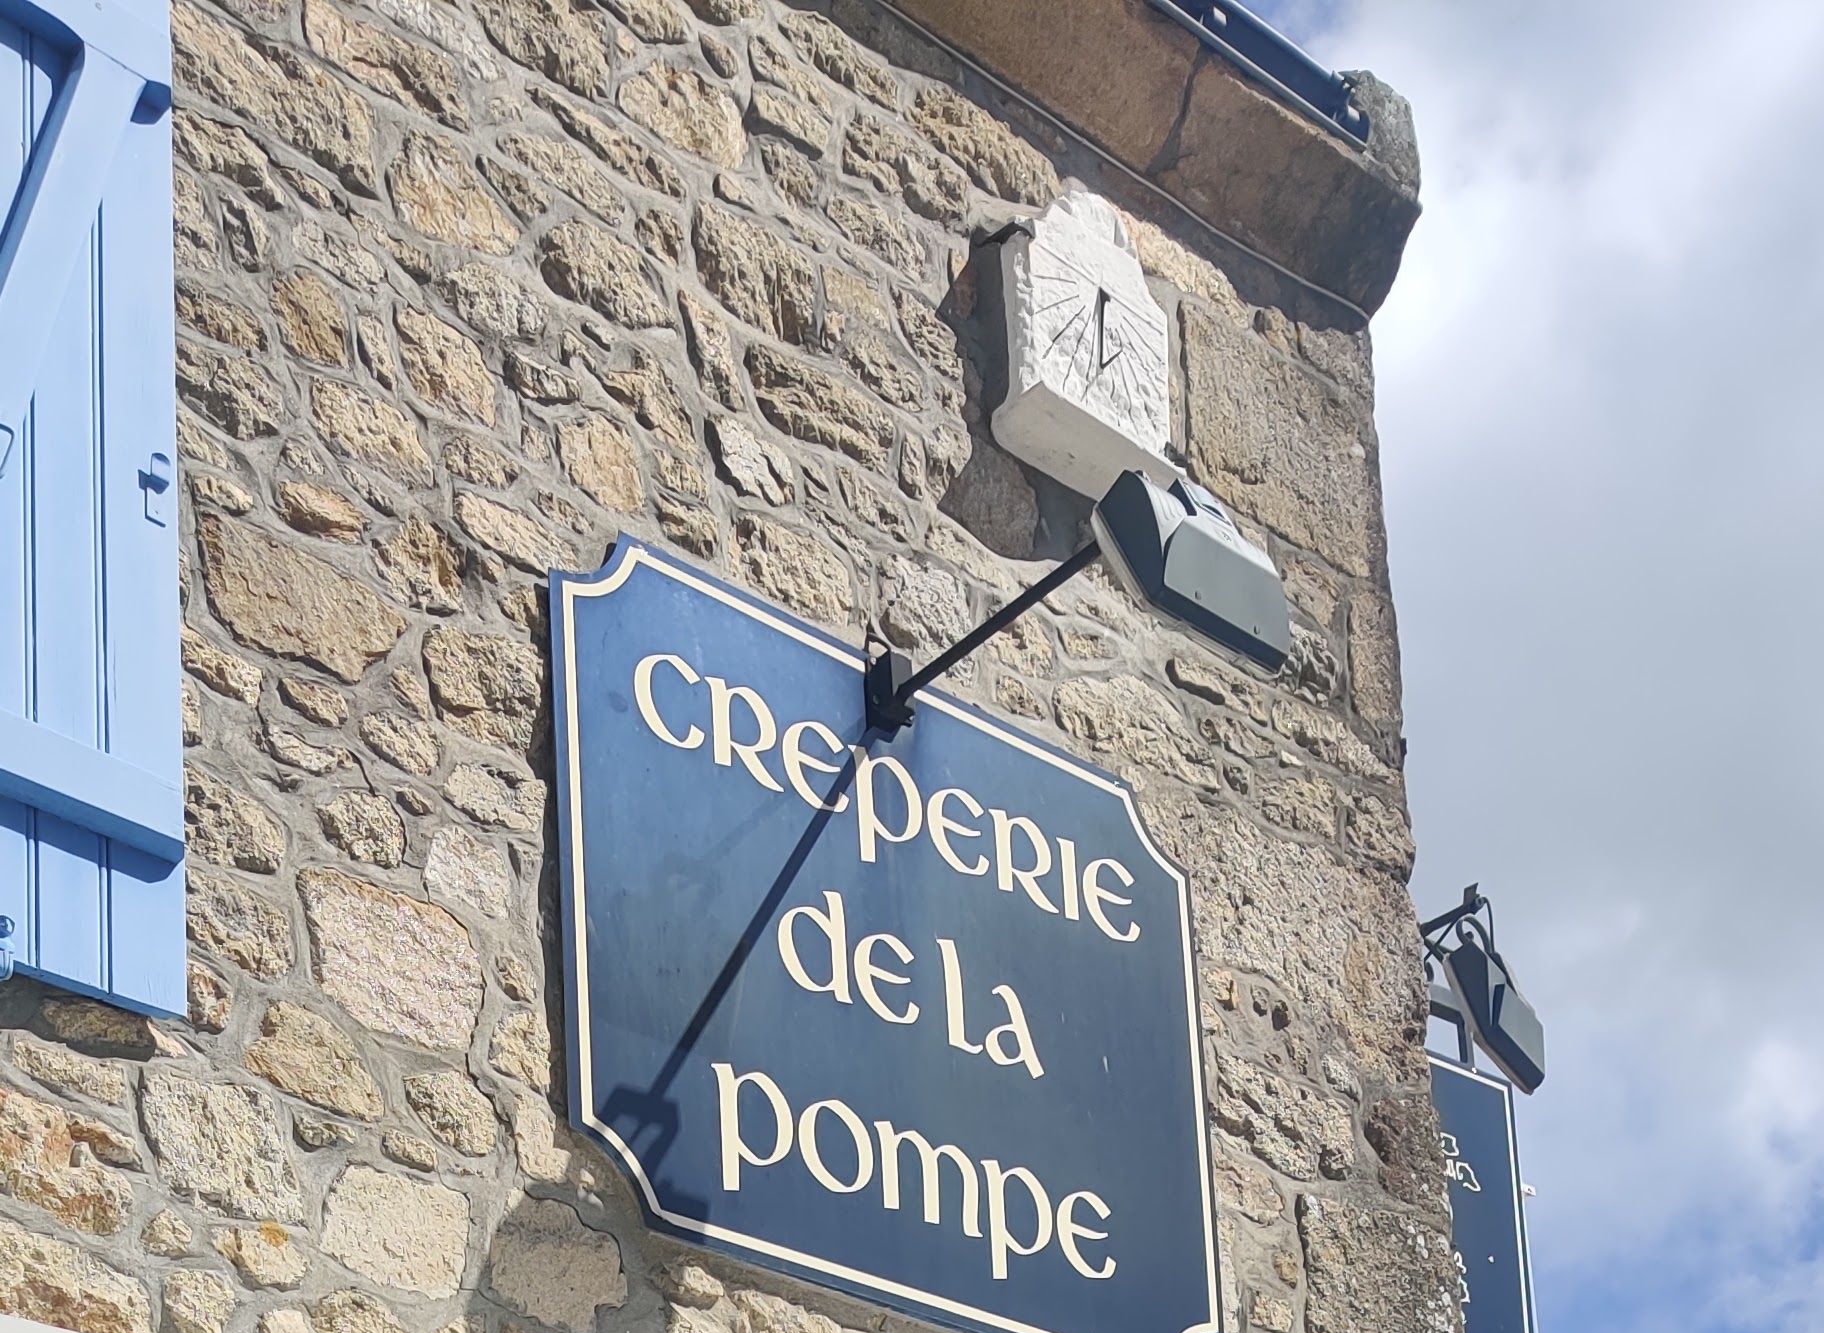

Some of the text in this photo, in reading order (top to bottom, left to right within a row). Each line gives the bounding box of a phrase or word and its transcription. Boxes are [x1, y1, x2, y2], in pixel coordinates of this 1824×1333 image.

[633, 653, 1141, 942] CREPERIE
[777, 891, 1045, 1079] de la
